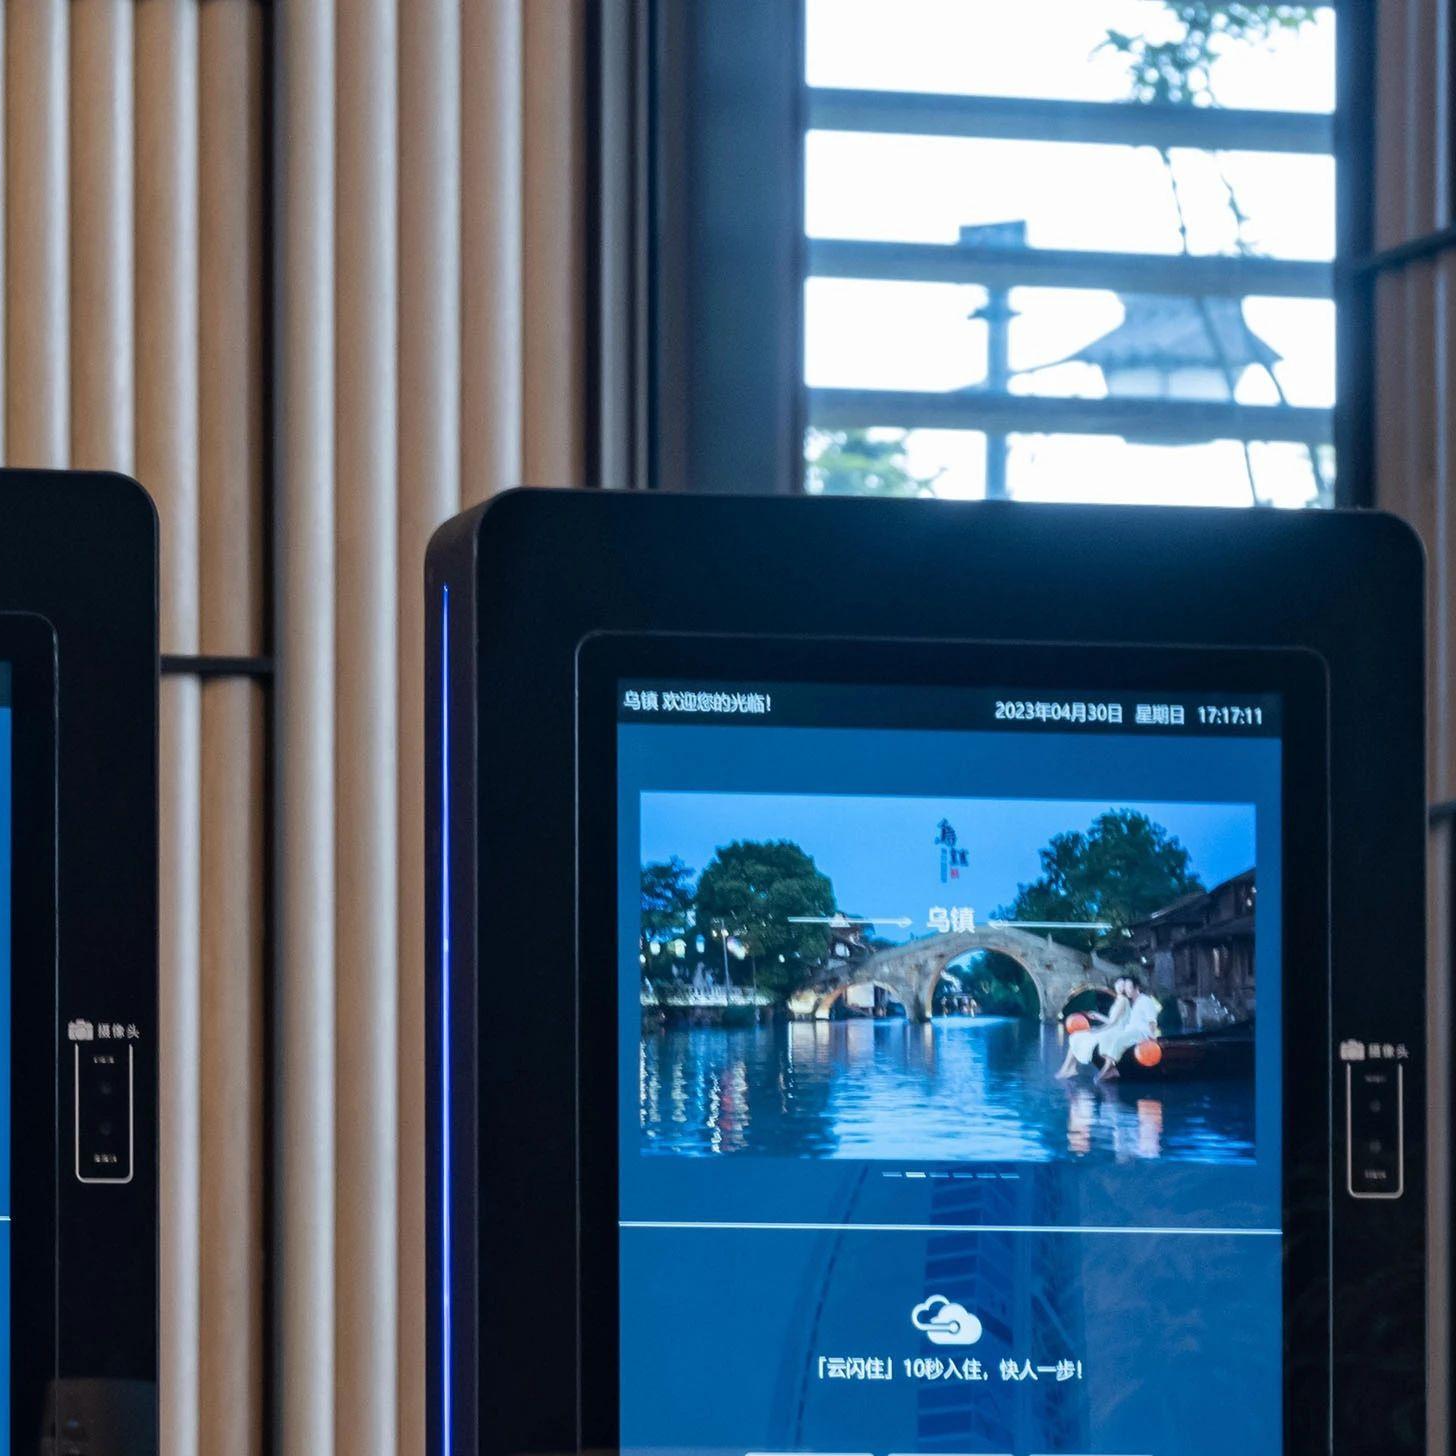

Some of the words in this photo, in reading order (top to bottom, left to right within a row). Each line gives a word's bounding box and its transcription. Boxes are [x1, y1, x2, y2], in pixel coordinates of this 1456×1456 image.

[623, 689, 659, 711] 乌镇
[994, 700, 1123, 724] 2023年04月30日
[1135, 703, 1185, 725] 星期日
[1197, 705, 1263, 725] 17:17:11
[927, 905, 975, 933] 乌镇
